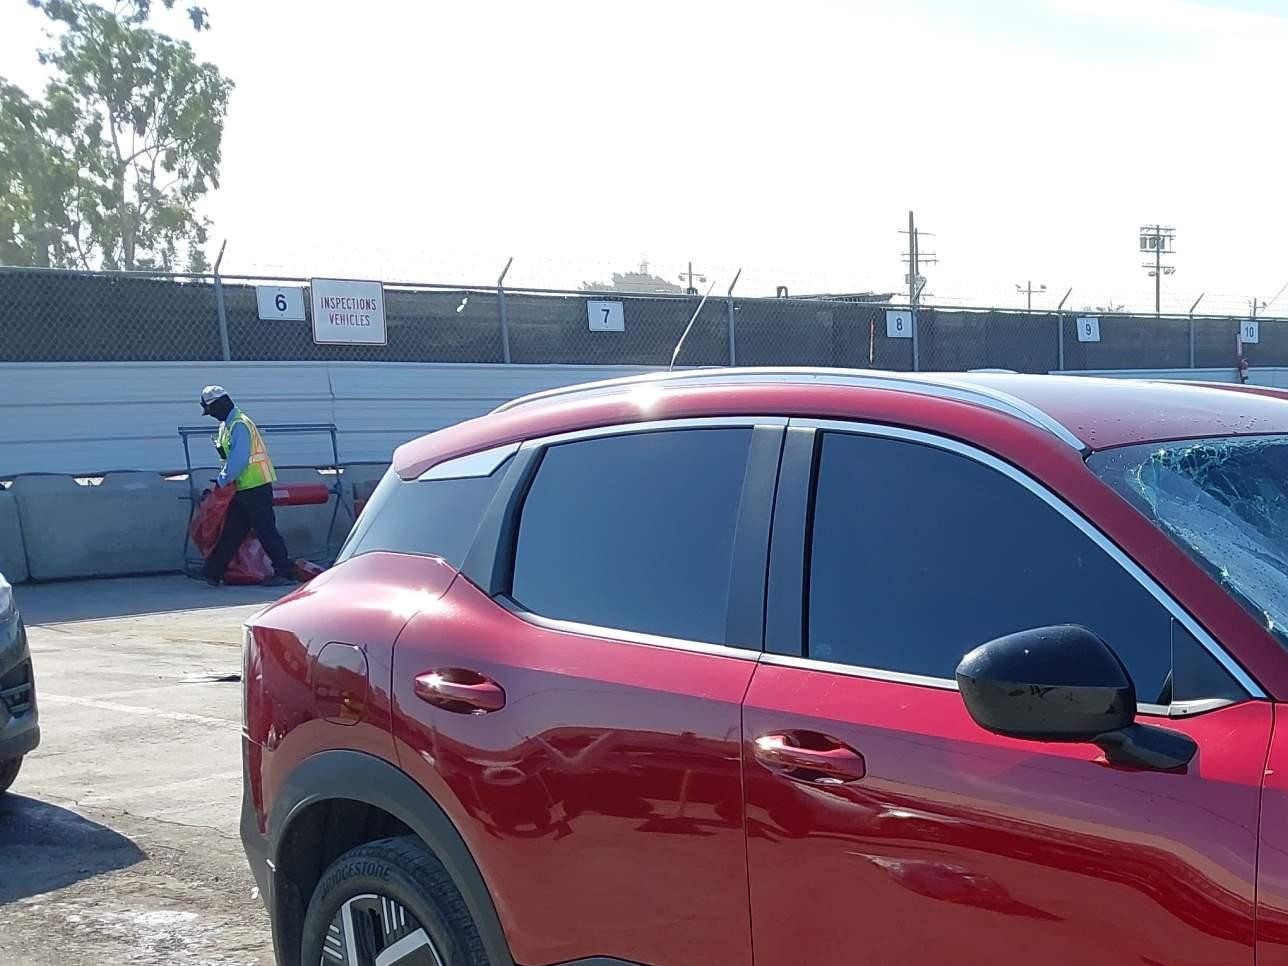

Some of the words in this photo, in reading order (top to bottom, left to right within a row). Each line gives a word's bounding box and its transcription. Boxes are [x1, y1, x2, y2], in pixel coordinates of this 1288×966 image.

[275, 294, 287, 311] 6
[320, 297, 377, 311] INSPECTIONS
[329, 313, 370, 327] VEHICLES
[601, 308, 610, 323] 7
[896, 317, 903, 331] 8
[1085, 323, 1092, 336] 9
[1245, 326, 1254, 338] 10
